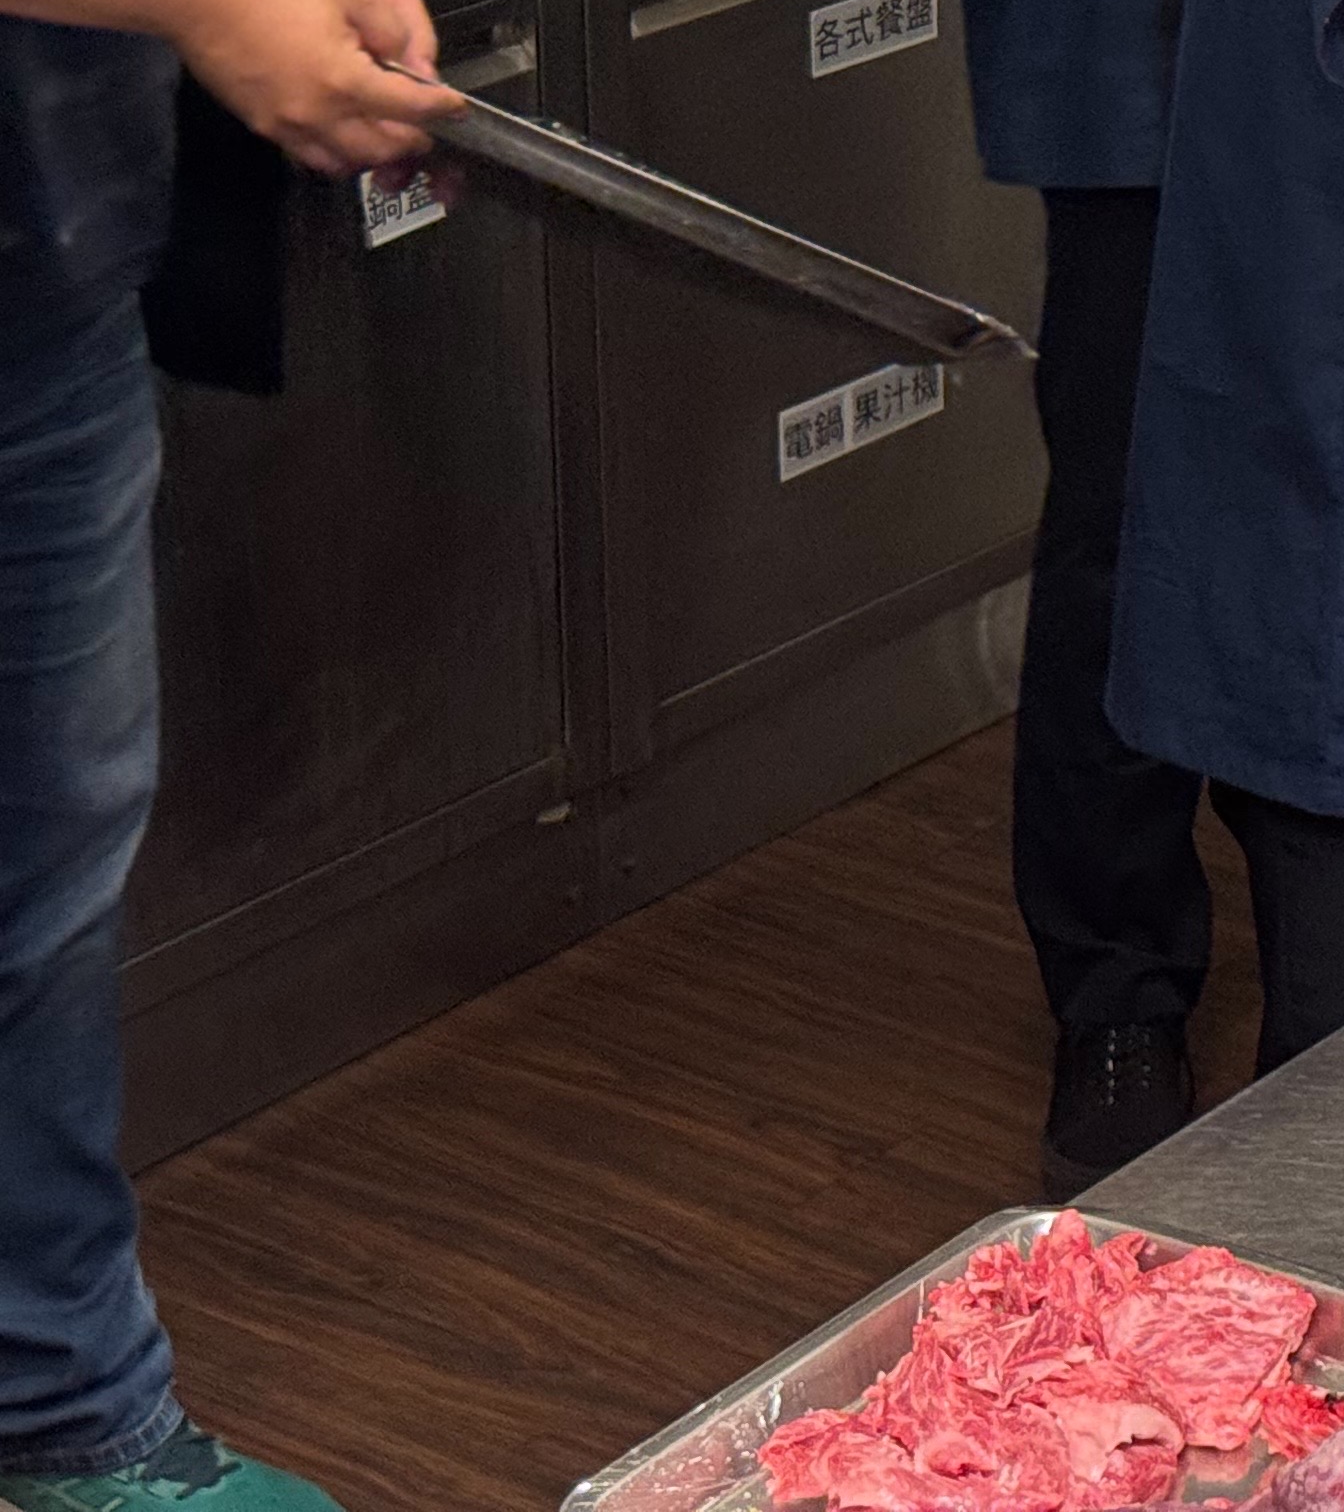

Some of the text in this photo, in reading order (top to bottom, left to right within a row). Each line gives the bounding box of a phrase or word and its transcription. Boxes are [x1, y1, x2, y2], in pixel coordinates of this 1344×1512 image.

[783, 366, 940, 460] 電鍋 果汁機
